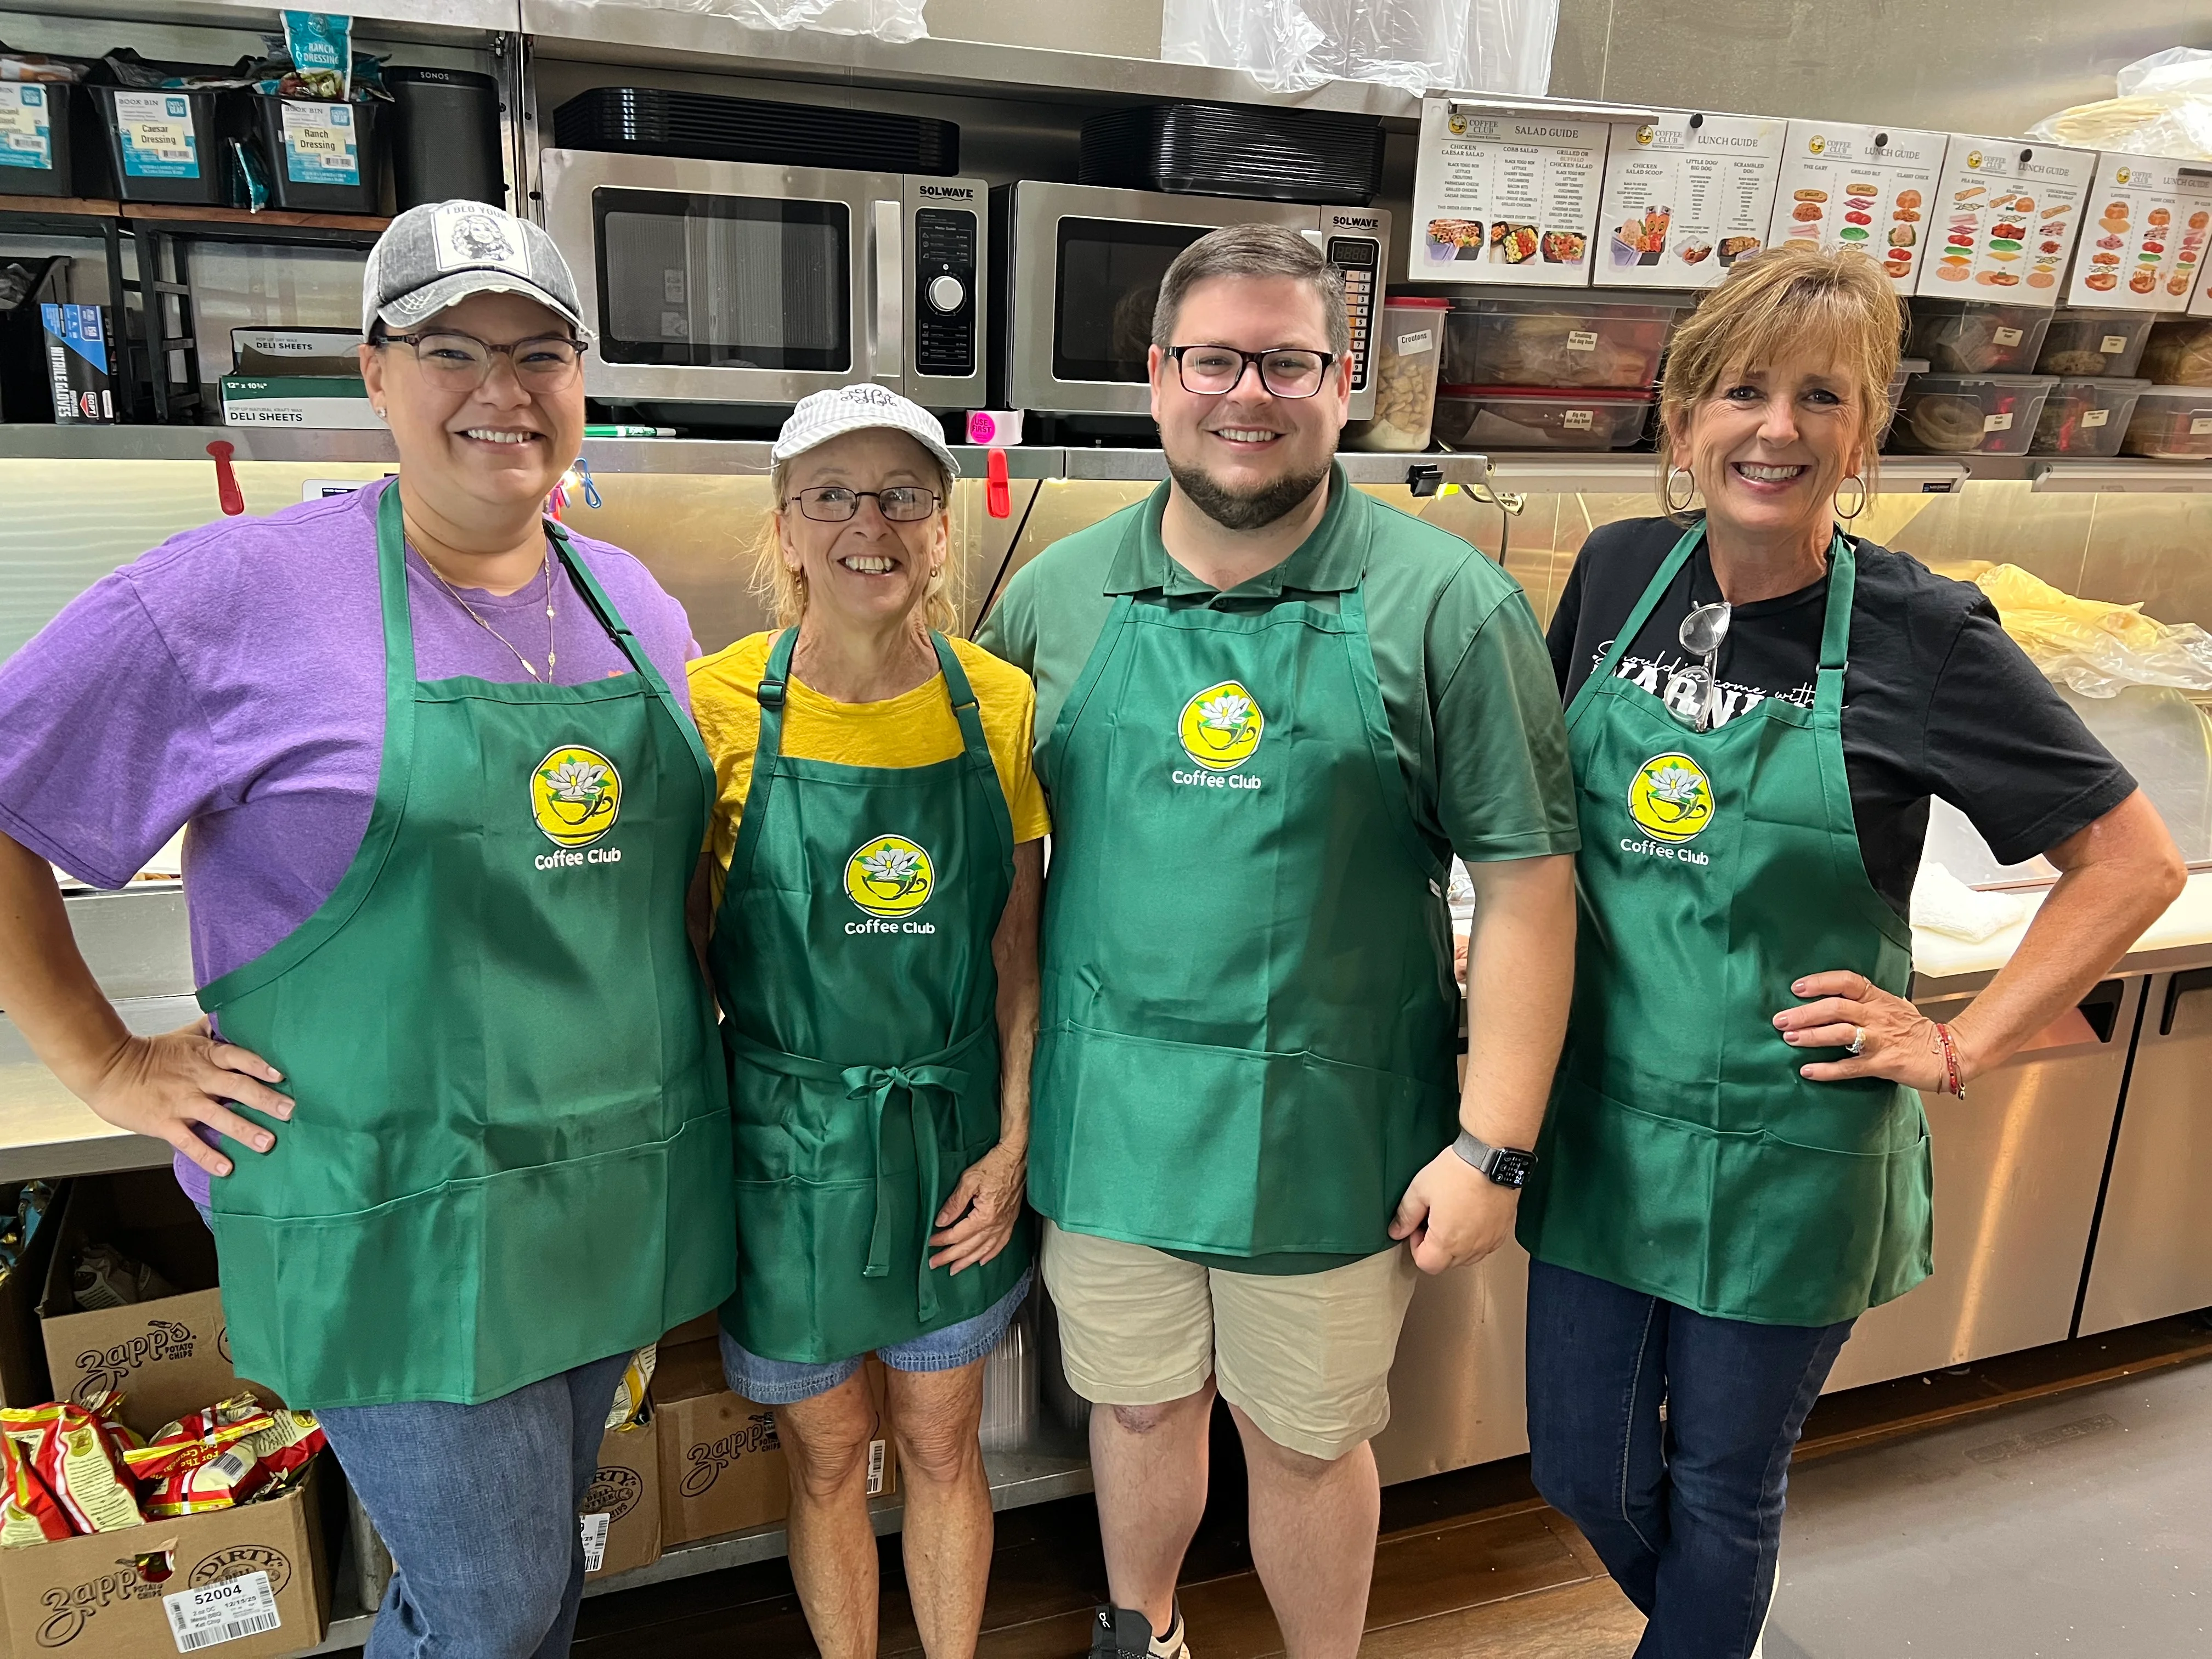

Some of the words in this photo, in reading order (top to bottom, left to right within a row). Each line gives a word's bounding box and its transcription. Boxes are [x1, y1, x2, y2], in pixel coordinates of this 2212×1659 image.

[308, 43, 334, 53] RANCH
[303, 52, 339, 65] DRESSING
[420, 72, 449, 80] SONOS
[1469, 119, 1498, 127] COFFEE
[142, 125, 168, 133] Caesar
[304, 129, 329, 138] Ranch
[1515, 126, 1547, 136] SALAD
[1549, 128, 1578, 138] GUIDE
[1655, 130, 1683, 138] COFFEE
[141, 135, 176, 145] Dressing
[300, 140, 335, 151] Dressing
[1698, 136, 1728, 145] LUNCH
[1731, 138, 1758, 147] GUIDE
[1865, 147, 1893, 157] LUNCH
[1895, 150, 1920, 159] GUIDE
[2018, 163, 2045, 173] LUNCH
[2046, 166, 2069, 176] GUIDE
[2163, 177, 2187, 186] LUNCH
[919, 185, 973, 198] SOLWAVE
[1333, 216, 1378, 228] SOLWAVE
[1402, 333, 1427, 343] Croutons
[50, 347, 67, 382] NITRILE
[54, 382, 71, 417] GLOVES
[259, 413, 303, 421] SHEETS
[1714, 679, 1767, 695] come
[1775, 682, 1816, 707] with
[1172, 770, 1225, 788] Coffee
[1228, 775, 1262, 789] Club
[1620, 838, 1675, 859] Coffee
[1678, 848, 1709, 866] Club
[534, 850, 584, 870] Coffee
[587, 848, 622, 864] Club
[844, 919, 899, 935] Coffee
[903, 922, 935, 934] Club
[165, 1343, 193, 1354] POTATO
[169, 1351, 192, 1360] CHIPS
[180, 1458, 200, 1466] The
[586, 1487, 610, 1502] DELI
[609, 1502, 628, 1519] HIPS
[137, 1590, 162, 1600] CHIPS
[195, 1584, 241, 1605] 52004
[206, 1619, 221, 1628] Chip
